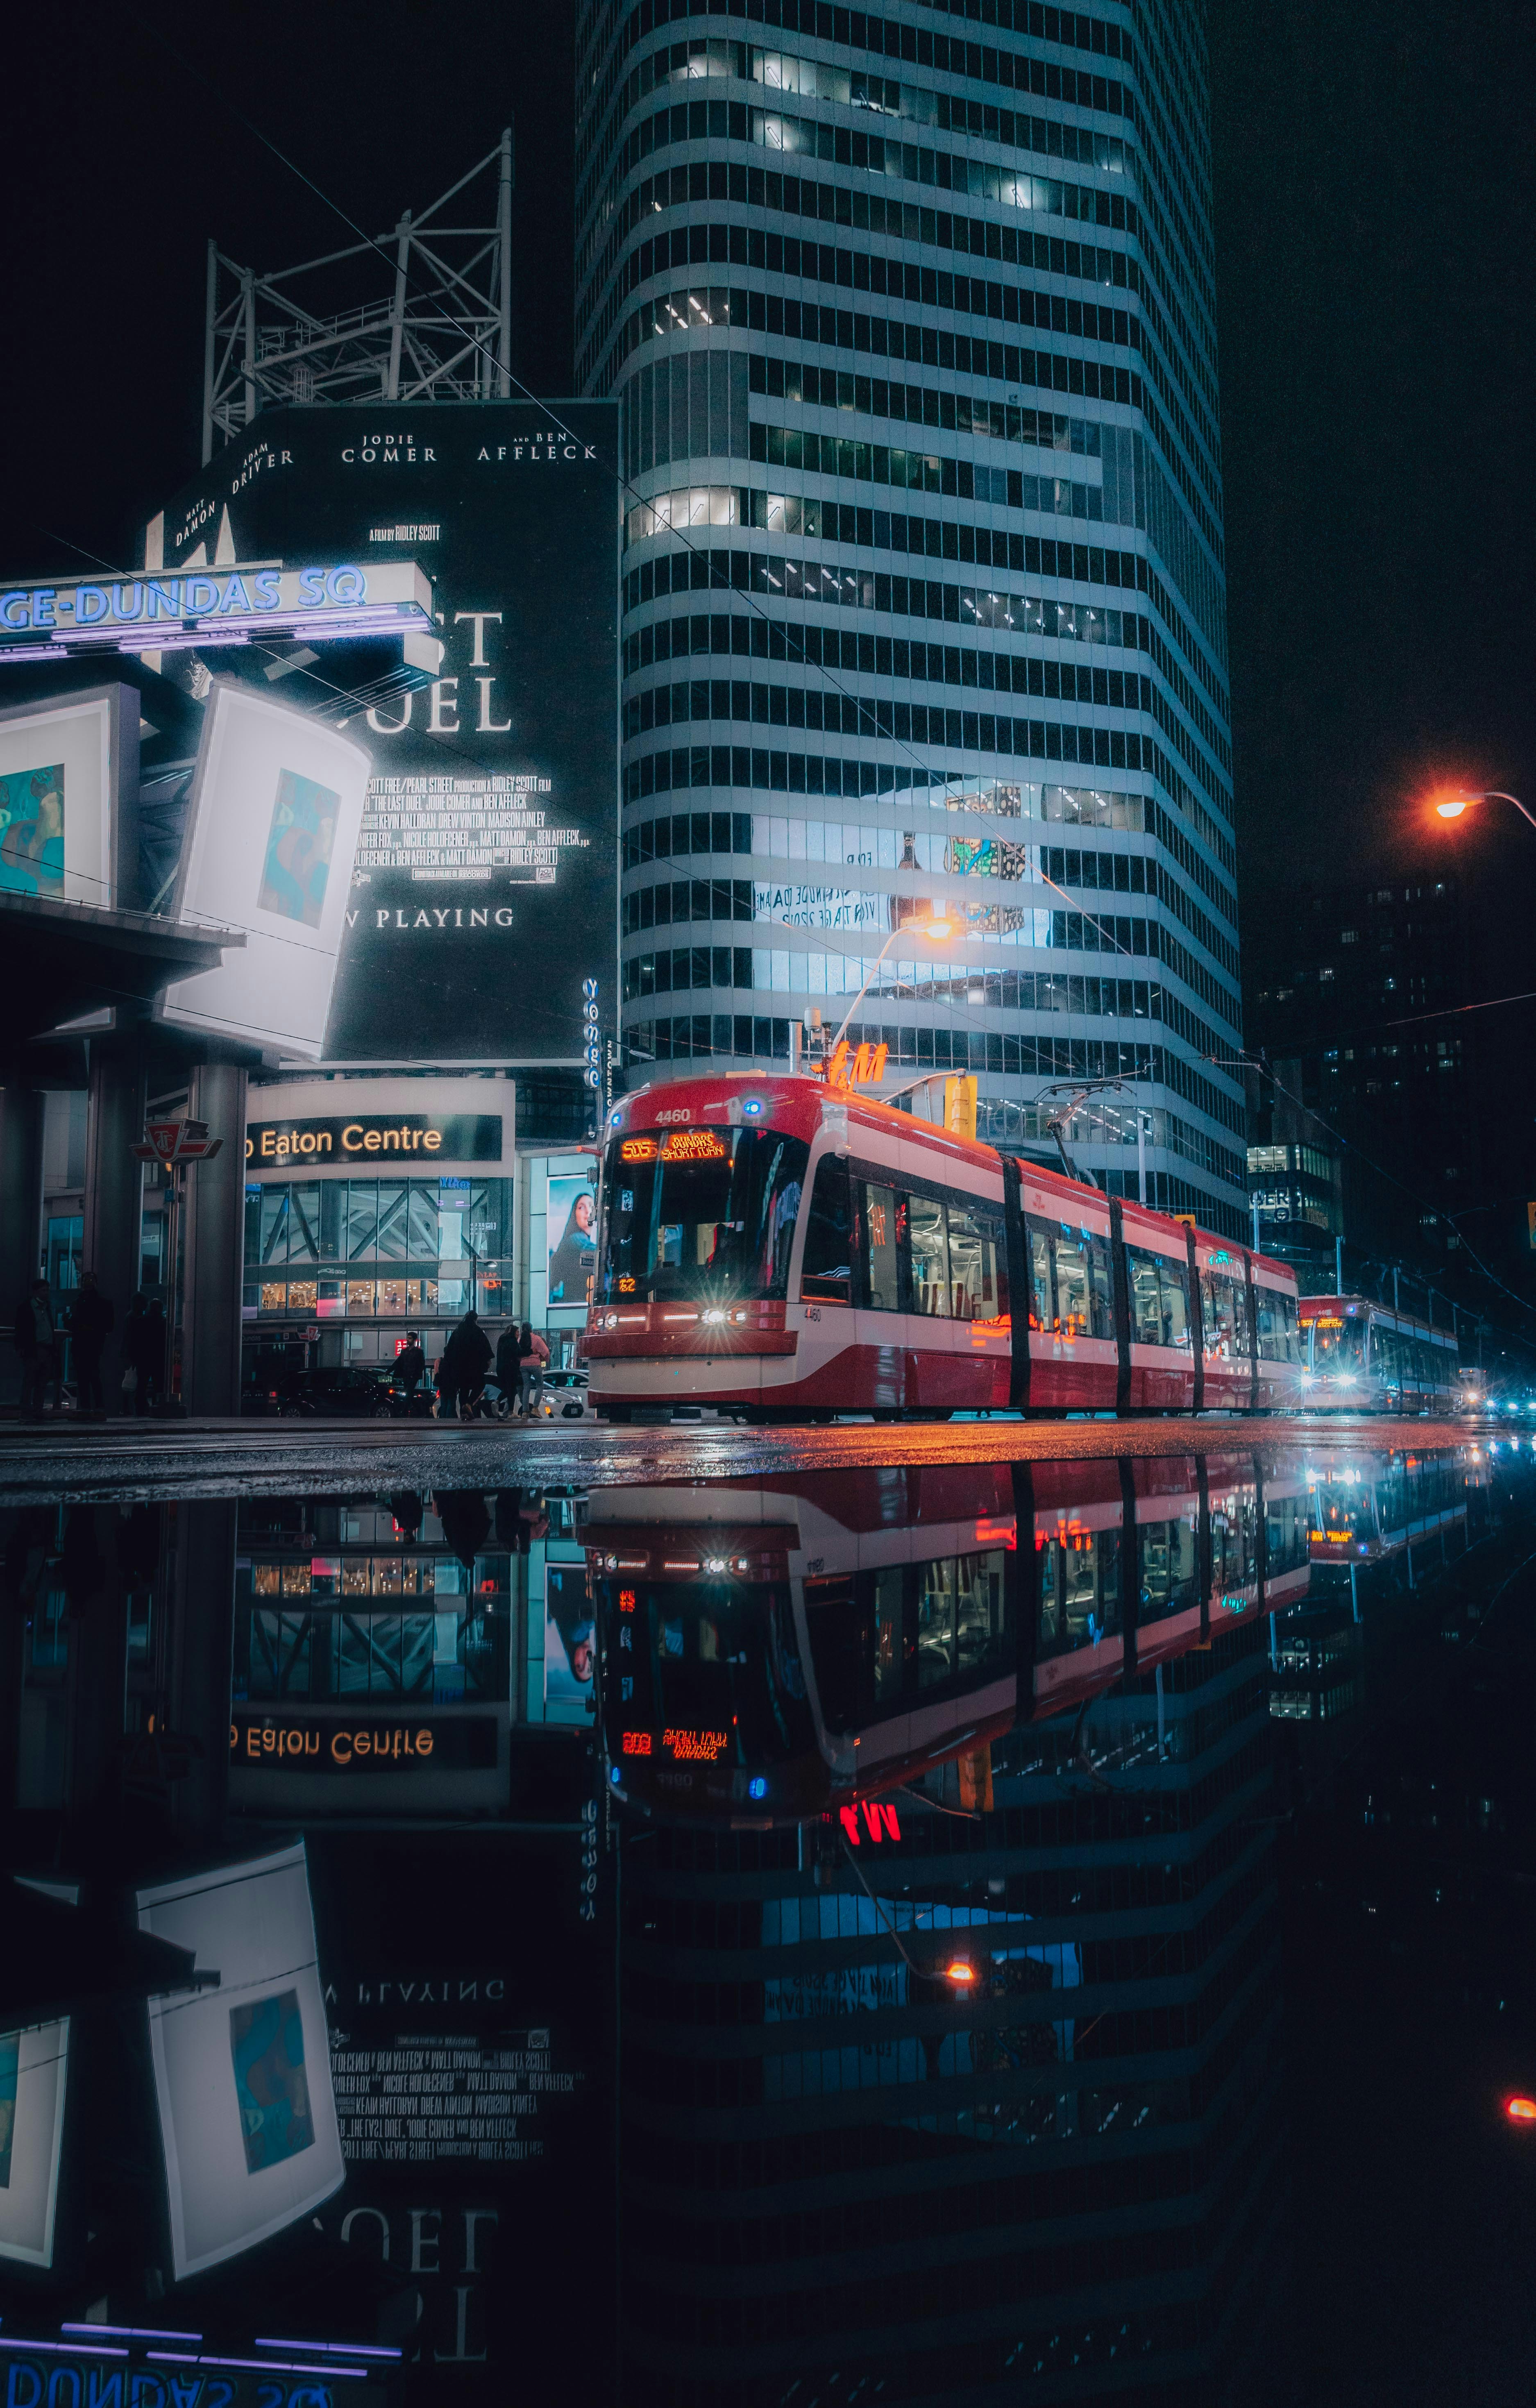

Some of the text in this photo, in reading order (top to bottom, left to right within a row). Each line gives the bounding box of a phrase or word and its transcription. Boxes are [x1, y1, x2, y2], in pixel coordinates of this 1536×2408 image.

[363, 435, 413, 447] JODIE
[536, 433, 566, 442] BEN
[243, 443, 268, 468] ADAM
[341, 448, 437, 462] COMER
[477, 446, 596, 460] AFFLECK
[233, 451, 293, 495] DRIVER
[186, 499, 204, 522] MATT
[176, 501, 215, 546] DAMON
[370, 525, 440, 541] A FILM BY RIDLEY SCOTT
[297, 565, 368, 607] SQ
[367, 677, 511, 733] UEL
[429, 777, 454, 793] STREET
[454, 780, 486, 793] PRODUCTION
[487, 780, 491, 792] A
[492, 776, 515, 792] RIDLEY
[516, 776, 538, 792] SCOTT
[538, 779, 551, 792] FILM
[388, 795, 405, 811] LAST
[426, 794, 445, 810] JODIE
[447, 794, 470, 810] COMER
[472, 798, 483, 810] AND
[484, 794, 497, 810] BEN
[498, 793, 527, 810] AFFLECK
[379, 811, 545, 829] KEVIN HALLORAN DREW VINTON MADISON AINLEY
[379, 832, 392, 848] FOX
[403, 831, 427, 848] NICOLE
[480, 830, 500, 847] MATT
[501, 830, 526, 847] DAMON
[537, 830, 550, 846] BEN
[391, 853, 396, 866] &
[397, 849, 410, 866] BEN
[411, 849, 440, 866] AFFLECK
[440, 852, 445, 865] &
[447, 849, 465, 865] MATT
[466, 849, 492, 865] DAMON
[510, 849, 533, 864] RIDLEY
[534, 848, 556, 864] SCOTT
[377, 908, 513, 928] PLAYING
[656, 1109, 691, 1123] 4460
[261, 1130, 332, 1156] Eaton
[342, 1124, 442, 1151] Centre
[672, 1134, 714, 1149] DUNDAS
[662, 1146, 724, 1159] SHORT TURN
